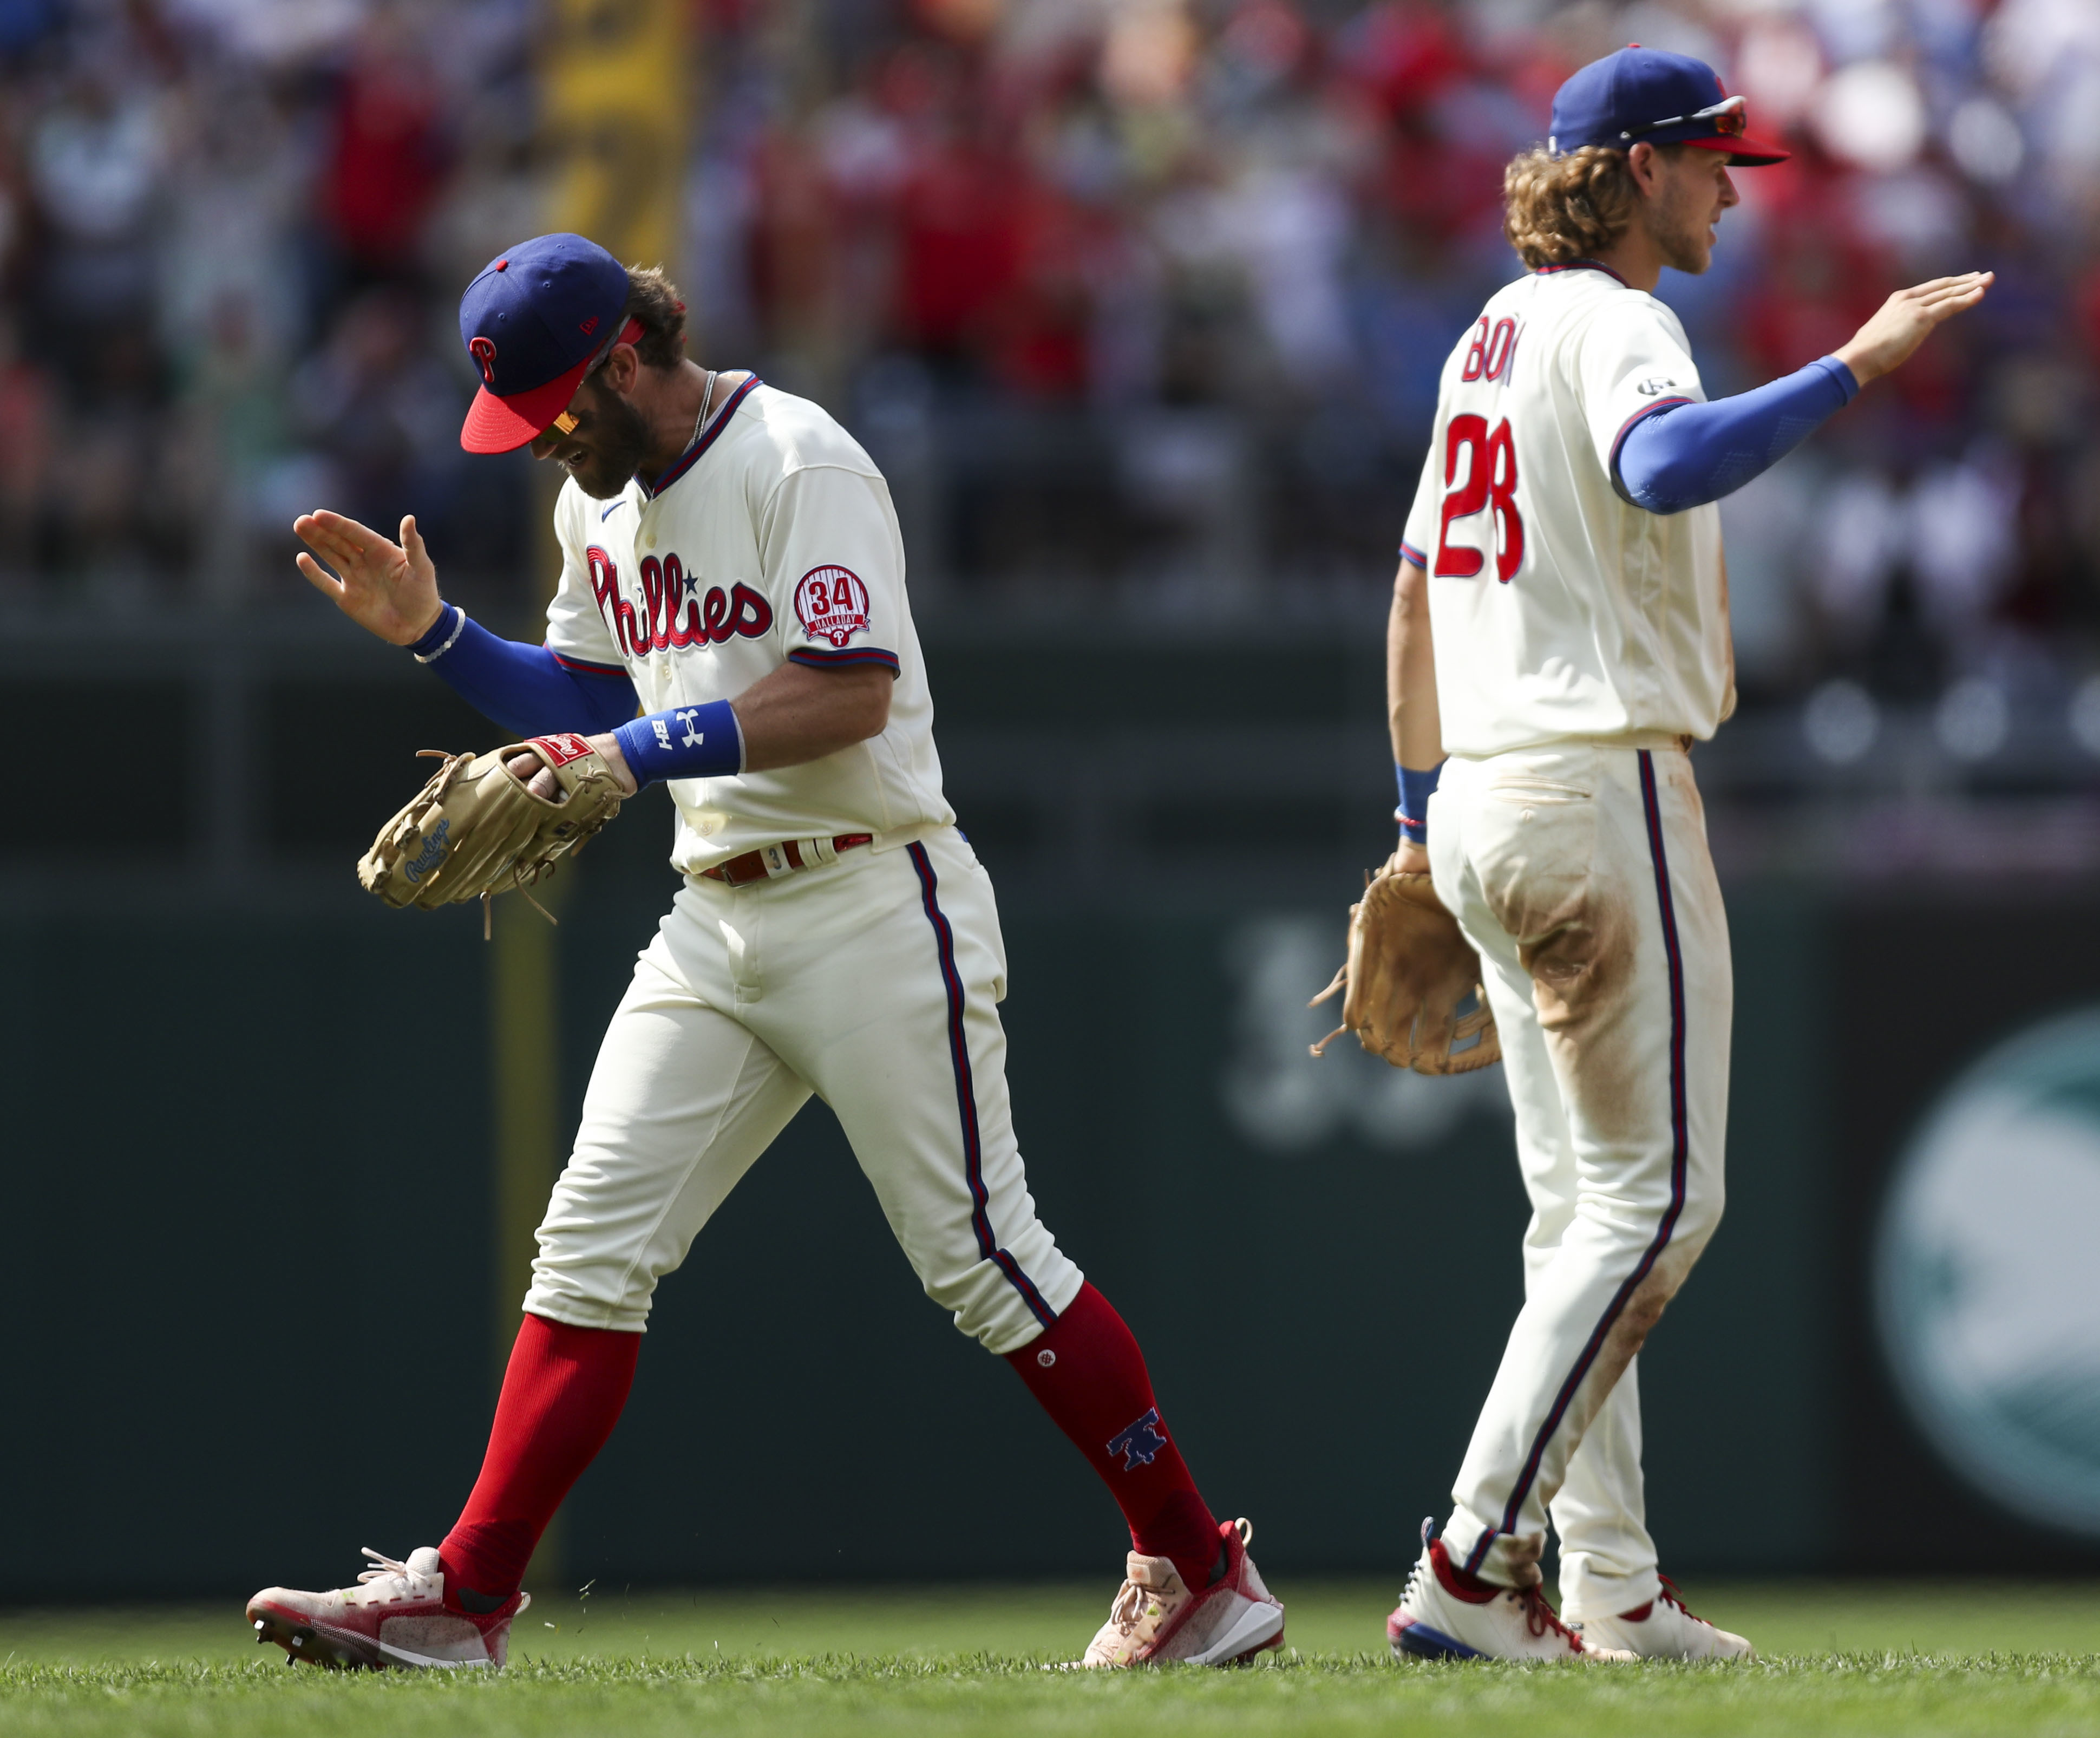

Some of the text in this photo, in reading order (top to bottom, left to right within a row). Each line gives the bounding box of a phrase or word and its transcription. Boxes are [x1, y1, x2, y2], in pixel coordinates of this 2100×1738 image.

[470, 337, 496, 383] P
[1434, 414, 1525, 584] 28
[586, 545, 773, 657] Phillies
[809, 577, 854, 615] 34
[814, 615, 856, 631] HALLADAY
[651, 719, 673, 750] BH
[404, 818, 450, 883] Rawlings
[768, 847, 782, 870] 3
